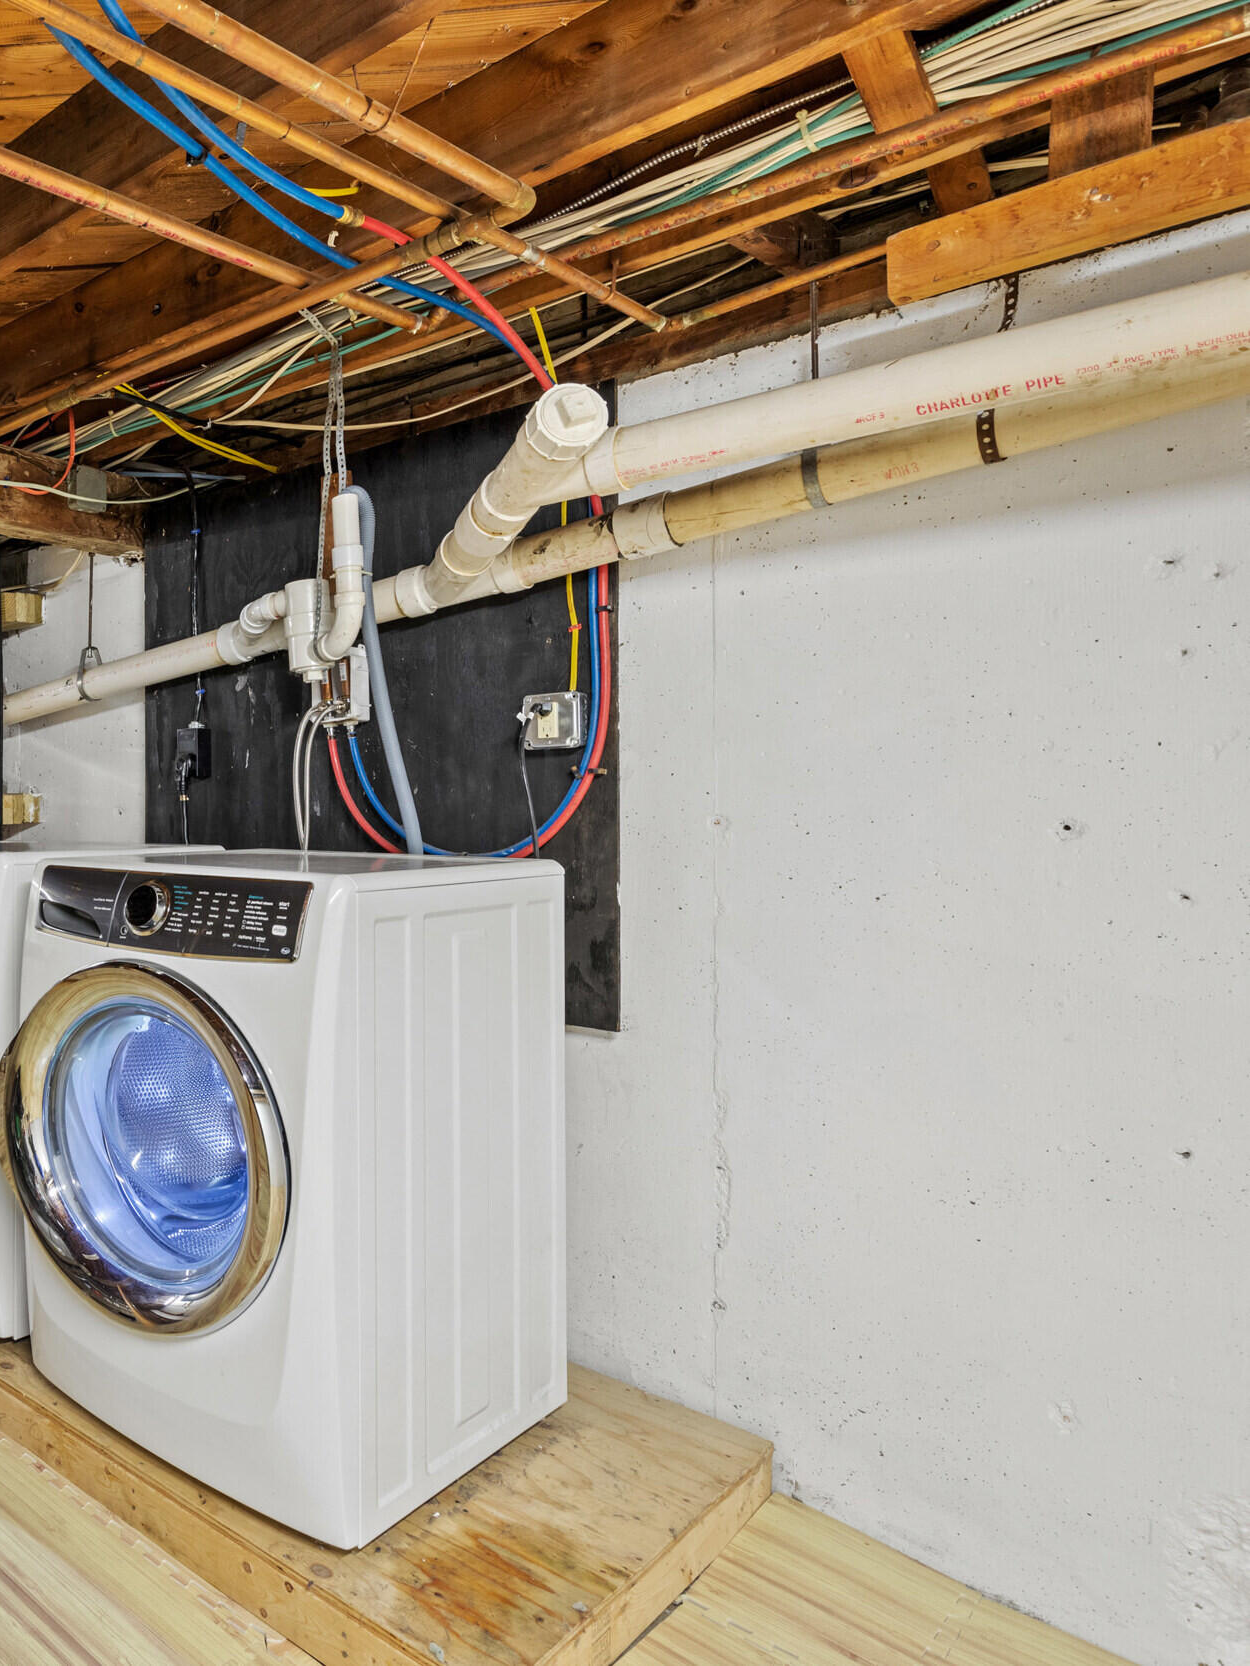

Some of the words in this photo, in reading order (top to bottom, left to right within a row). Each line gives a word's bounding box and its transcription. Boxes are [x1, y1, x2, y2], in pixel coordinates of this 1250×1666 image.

[1124, 354, 1145, 364] PVC
[1151, 346, 1177, 359] TYPE
[916, 384, 1012, 416] CHARLOTTE
[1025, 374, 1066, 392] PIPE
